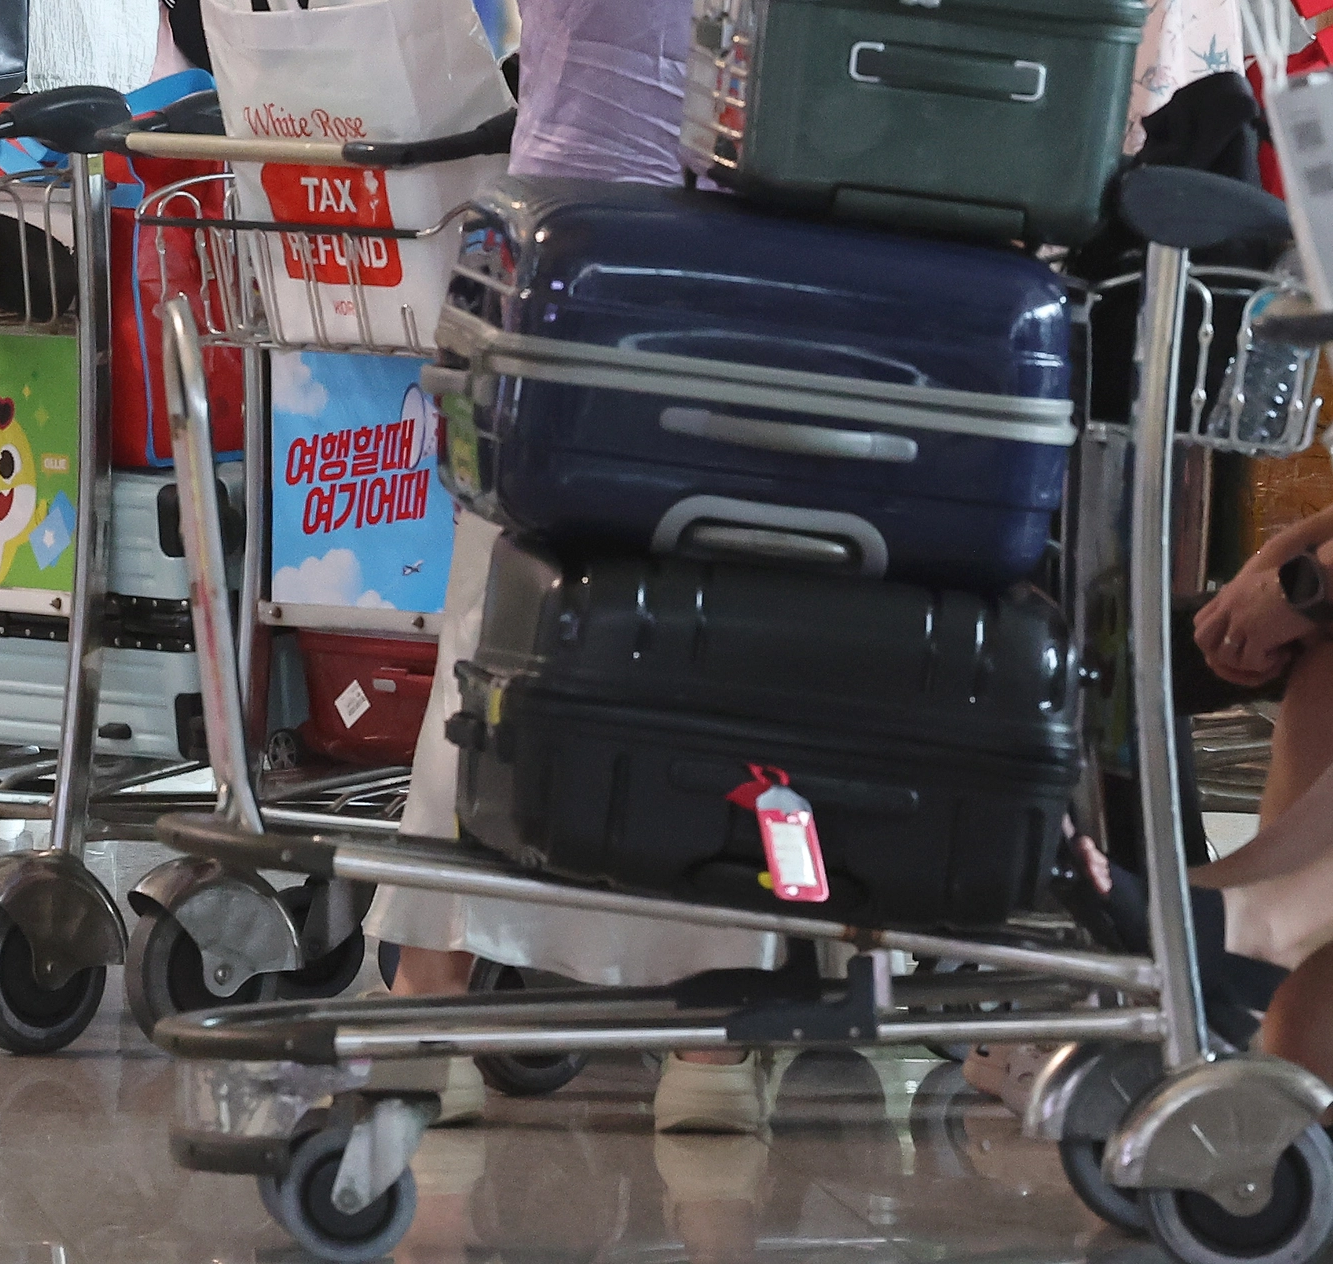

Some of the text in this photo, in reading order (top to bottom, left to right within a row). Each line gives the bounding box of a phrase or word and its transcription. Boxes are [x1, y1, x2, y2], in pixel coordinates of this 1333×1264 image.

[244, 103, 368, 142] White Rose
[300, 177, 358, 213] TAX
[285, 418, 416, 486] 여행할때
[302, 469, 430, 535] 여기어때
